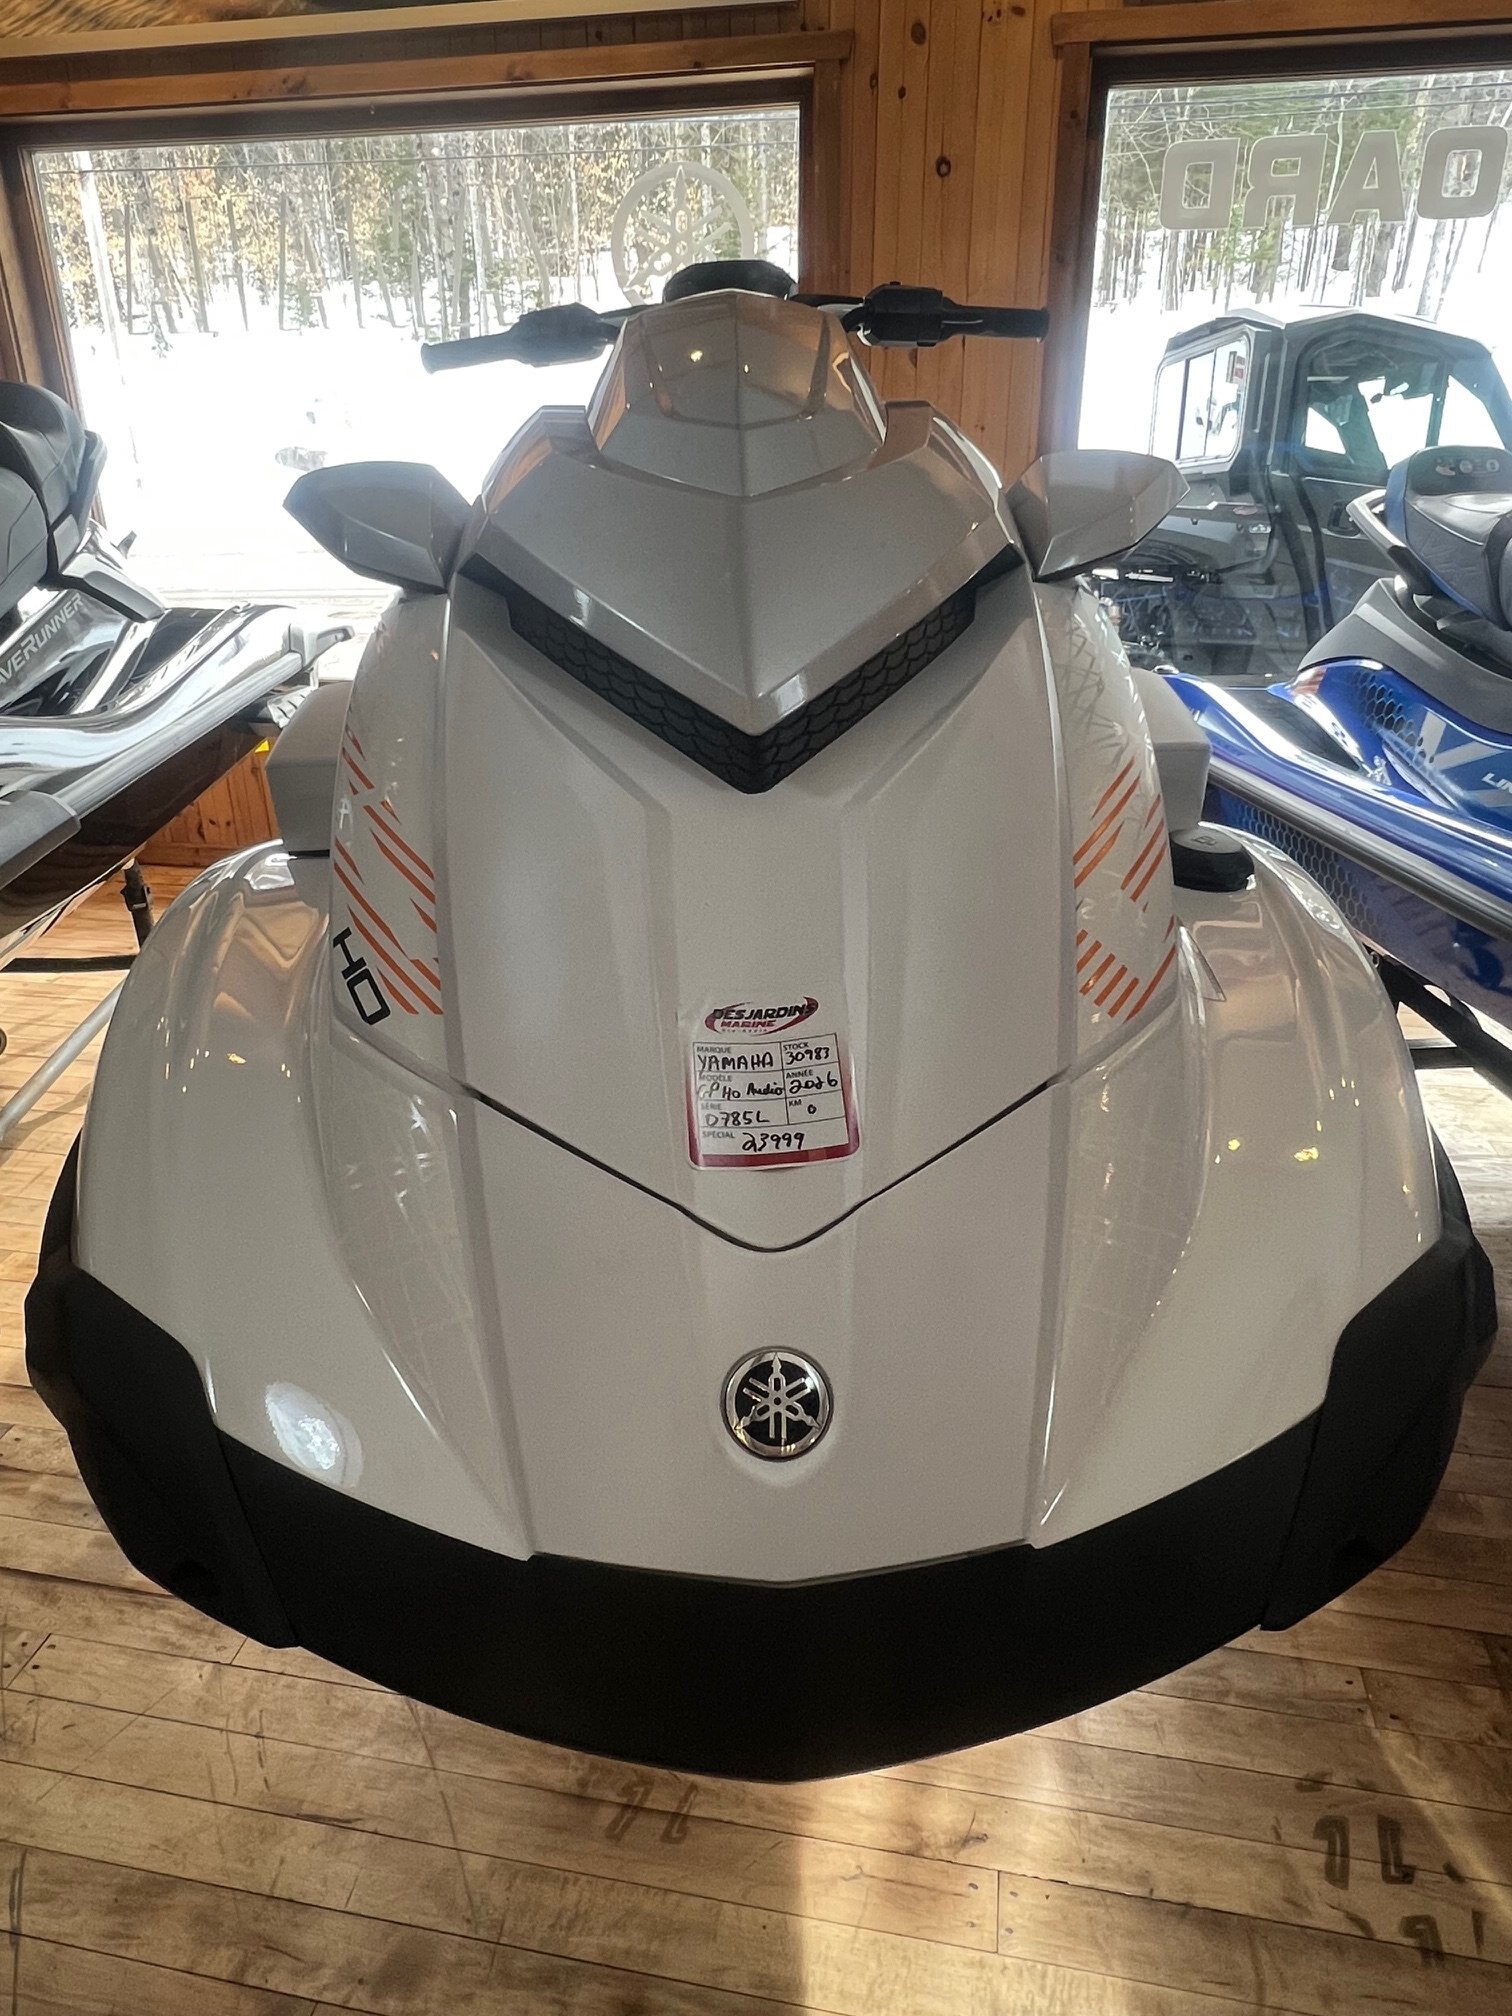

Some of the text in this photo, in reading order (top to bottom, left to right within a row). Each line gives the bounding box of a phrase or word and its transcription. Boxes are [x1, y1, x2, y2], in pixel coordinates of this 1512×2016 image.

[333, 927, 391, 1025] HO
[720, 1020, 776, 1028] MARINE
[696, 1046, 731, 1054] MARQUE
[783, 1042, 809, 1051] STOCK
[698, 1052, 773, 1073] YAMAHA
[785, 1047, 830, 1065] 30983
[746, 1082, 784, 1095] Audio
[789, 1071, 838, 1094] 2026
[742, 1132, 805, 1152] 23999
